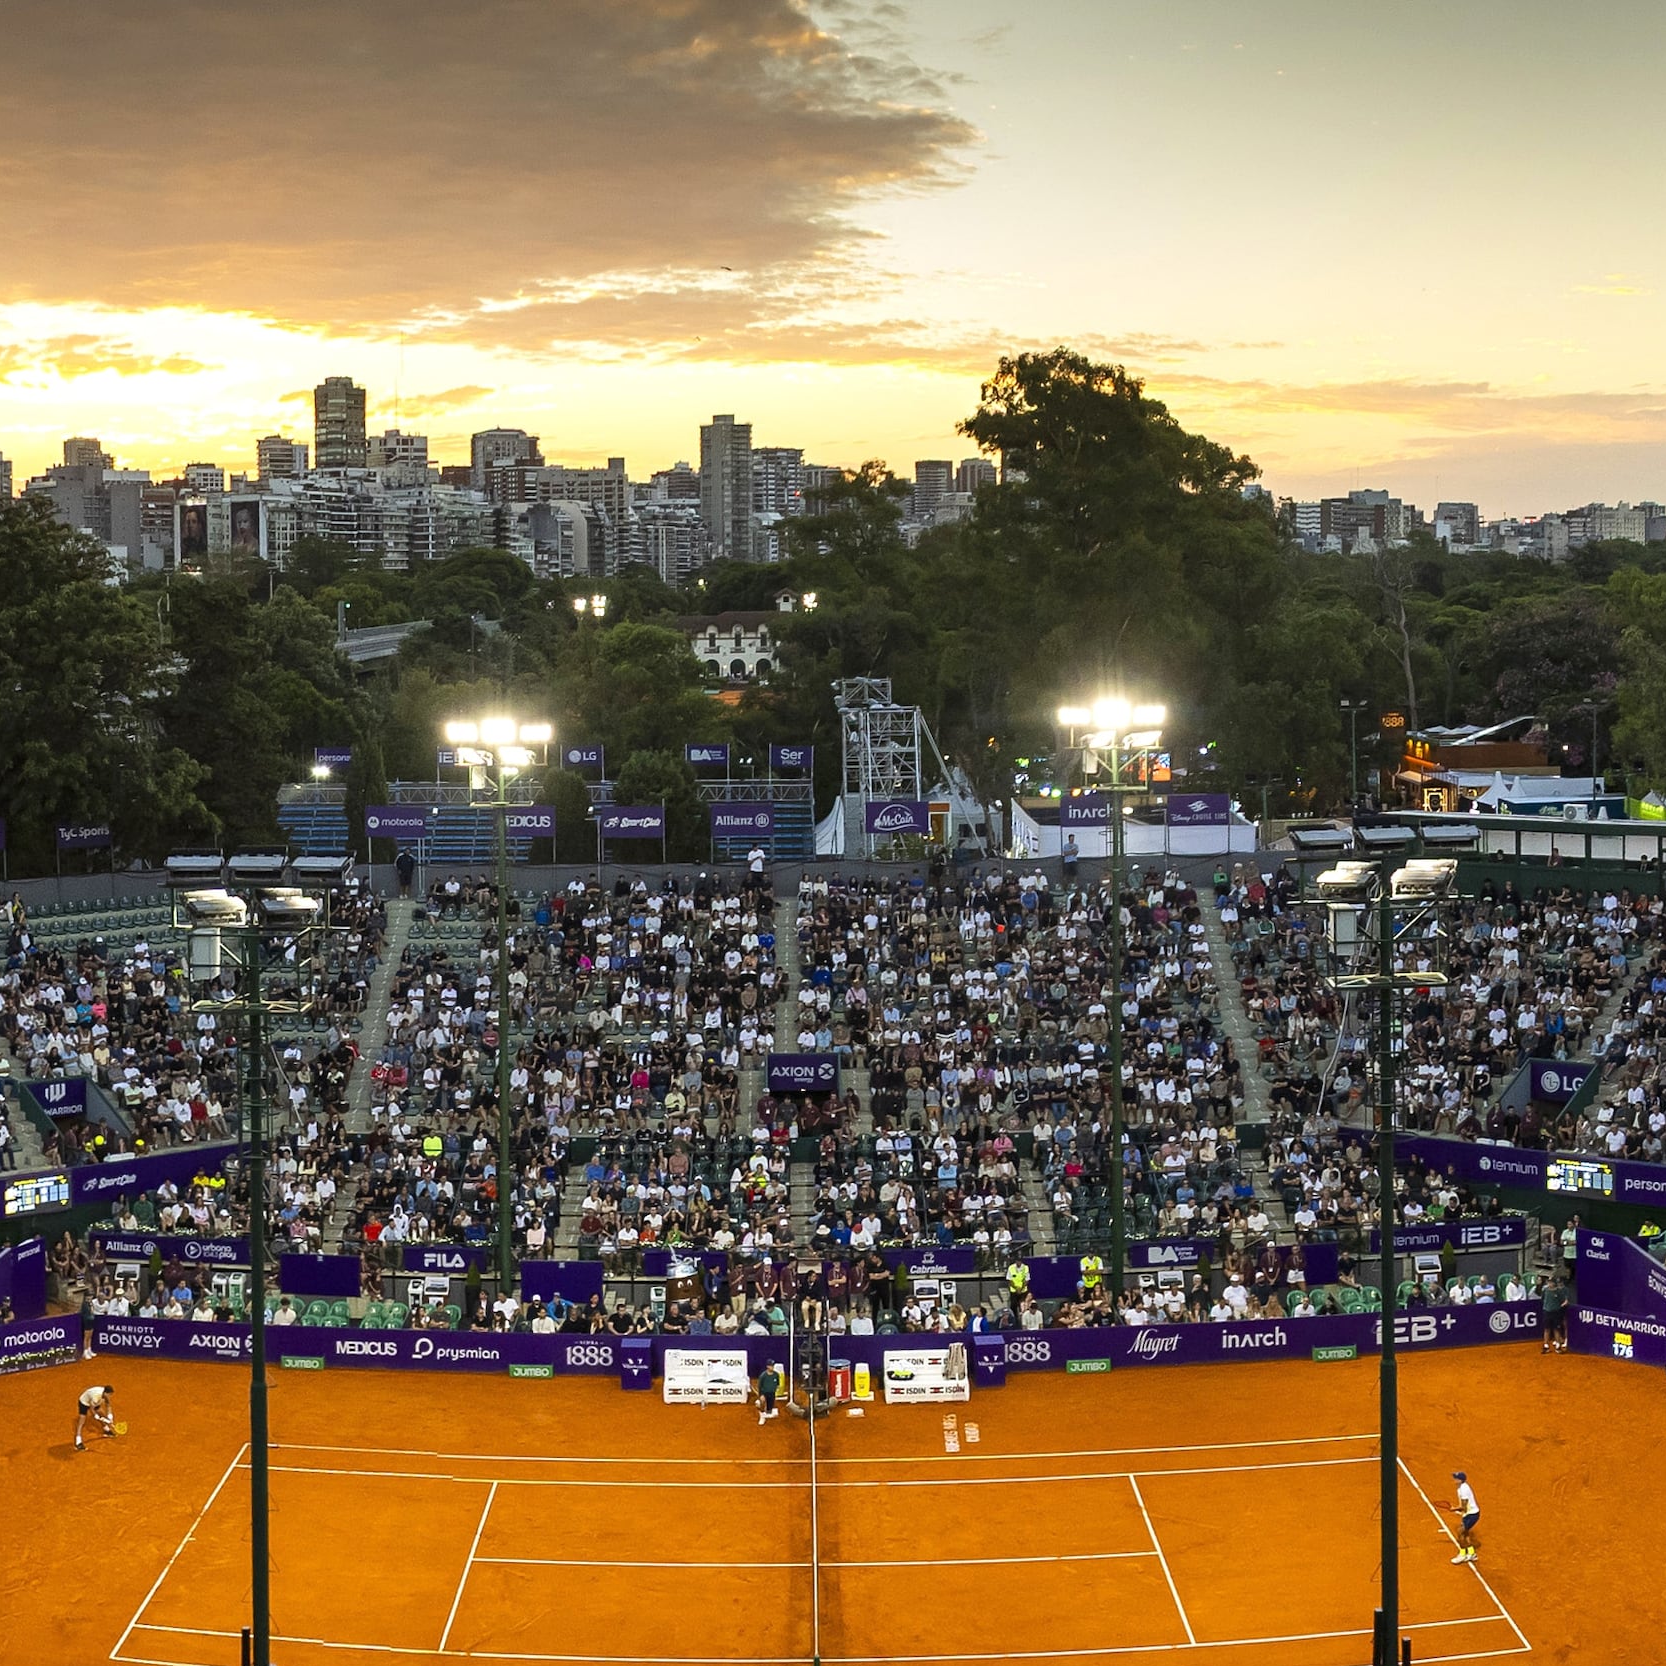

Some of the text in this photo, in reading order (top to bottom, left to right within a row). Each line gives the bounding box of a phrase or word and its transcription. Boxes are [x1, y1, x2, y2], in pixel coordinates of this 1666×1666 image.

[318, 755, 350, 764] persona
[583, 751, 597, 761] LG
[691, 749, 712, 761] BA
[780, 748, 804, 760] Ser
[381, 817, 423, 827] motorola
[504, 815, 551, 828] EDICUS
[619, 815, 662, 828] SportClub
[715, 814, 753, 825] Allianz
[883, 812, 914, 828] McCain
[771, 1066, 814, 1077] AXION
[1563, 1075, 1584, 1092] LG
[1492, 1158, 1538, 1176] tennium
[98, 1174, 137, 1190] SportClub
[17, 1244, 42, 1261] personal
[106, 1241, 142, 1252] Allianz
[219, 1252, 237, 1260] play
[1148, 1246, 1178, 1263] BA
[423, 1253, 466, 1269] FILA
[910, 1264, 948, 1275] Cabrales
[1514, 1311, 1537, 1329] LG
[1596, 1313, 1666, 1338] BETWARRIOR
[107, 1324, 155, 1335] MARRIOTT
[3, 1327, 65, 1347] motorola
[99, 1332, 163, 1349] BONVOY
[189, 1334, 241, 1350] AXION
[335, 1340, 398, 1356] MEDICUS
[1128, 1328, 1182, 1360] Magret
[436, 1346, 500, 1362] prysmian
[566, 1344, 614, 1367] 1888
[1317, 1348, 1353, 1360] JUMBO
[1612, 1343, 1634, 1359] 176
[284, 1357, 319, 1369] JUMBO
[684, 1358, 704, 1367] ISDIN
[722, 1359, 743, 1367] ISDIN
[1070, 1361, 1107, 1373] JUMBO
[513, 1365, 550, 1378] JUMBO
[683, 1387, 704, 1396] ISDIN
[722, 1388, 743, 1396] ISDIN
[906, 1386, 926, 1395] ISDIN
[945, 1385, 965, 1395] ISDIN
